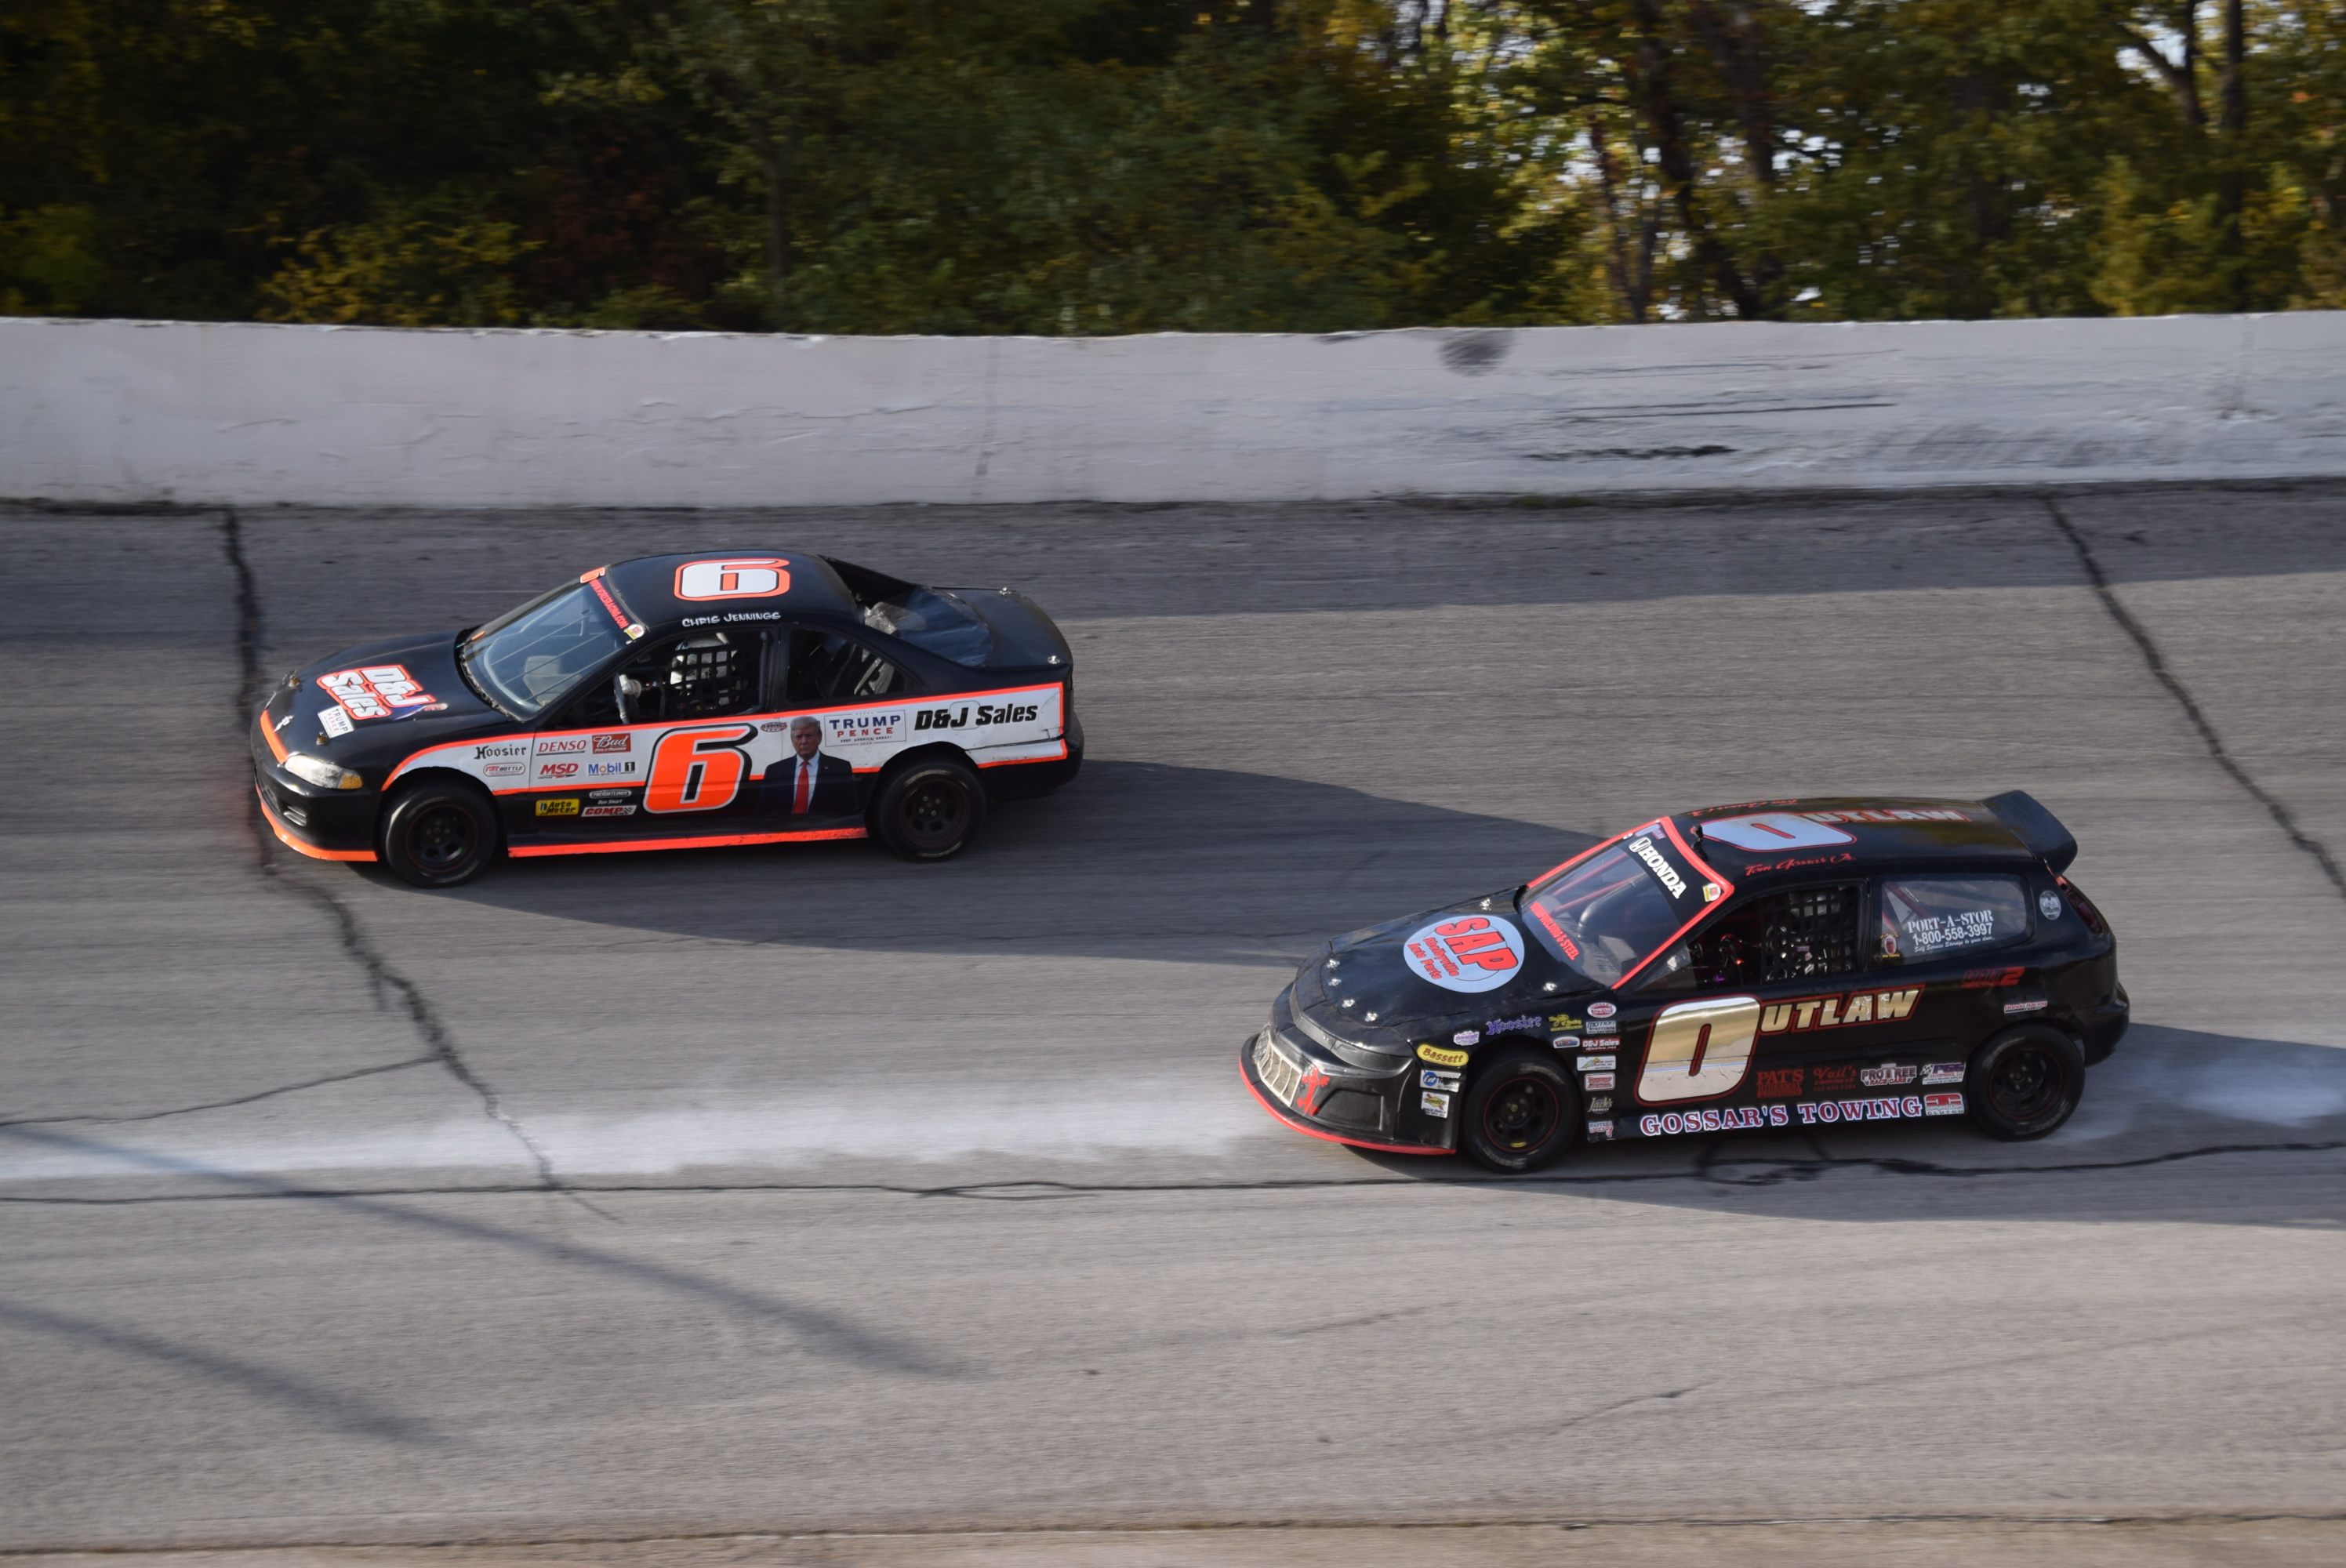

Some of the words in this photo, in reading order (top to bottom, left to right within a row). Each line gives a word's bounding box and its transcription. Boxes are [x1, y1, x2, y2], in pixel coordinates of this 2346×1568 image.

[674, 557, 790, 601] 6
[681, 615, 720, 627] CHRIS
[723, 612, 781, 622] JENNINGS
[317, 670, 391, 720] Sales
[358, 665, 436, 707] D&J
[332, 708, 349, 731] TRUMP
[829, 714, 901, 730] TRUMP
[914, 707, 969, 731] D&J
[975, 703, 1038, 726] Sales
[593, 735, 630, 749] Bud
[837, 727, 894, 738] PENCE
[474, 744, 527, 760] Hoosier
[539, 739, 586, 753] DENSO
[539, 763, 579, 775] MSD
[588, 762, 622, 775] Mobil
[625, 762, 635, 772] 1
[643, 723, 757, 814] 6
[584, 807, 624, 815] COMP
[1638, 845, 1687, 899] HONDA
[1745, 864, 1772, 877] Tom
[1907, 909, 1994, 934] PORT-A-STOR
[1435, 917, 1519, 971] SAP
[1540, 913, 1563, 938] WELDING
[1560, 939, 1580, 960] STEEL
[1912, 923, 1992, 946] 1-800-558-3997
[1423, 937, 1460, 977] Shelbyville
[1421, 959, 1443, 980] Parts
[1486, 1014, 1542, 1036] Hoosier
[1422, 1047, 1464, 1064] Bassett
[1756, 1069, 1804, 1086] PAT'S
[1813, 1064, 1858, 1080] Vail's
[1587, 1097, 1613, 1112] Jack's
[1640, 1105, 1789, 1136] GOSSAR'S
[1796, 1096, 1923, 1123] TOWING
